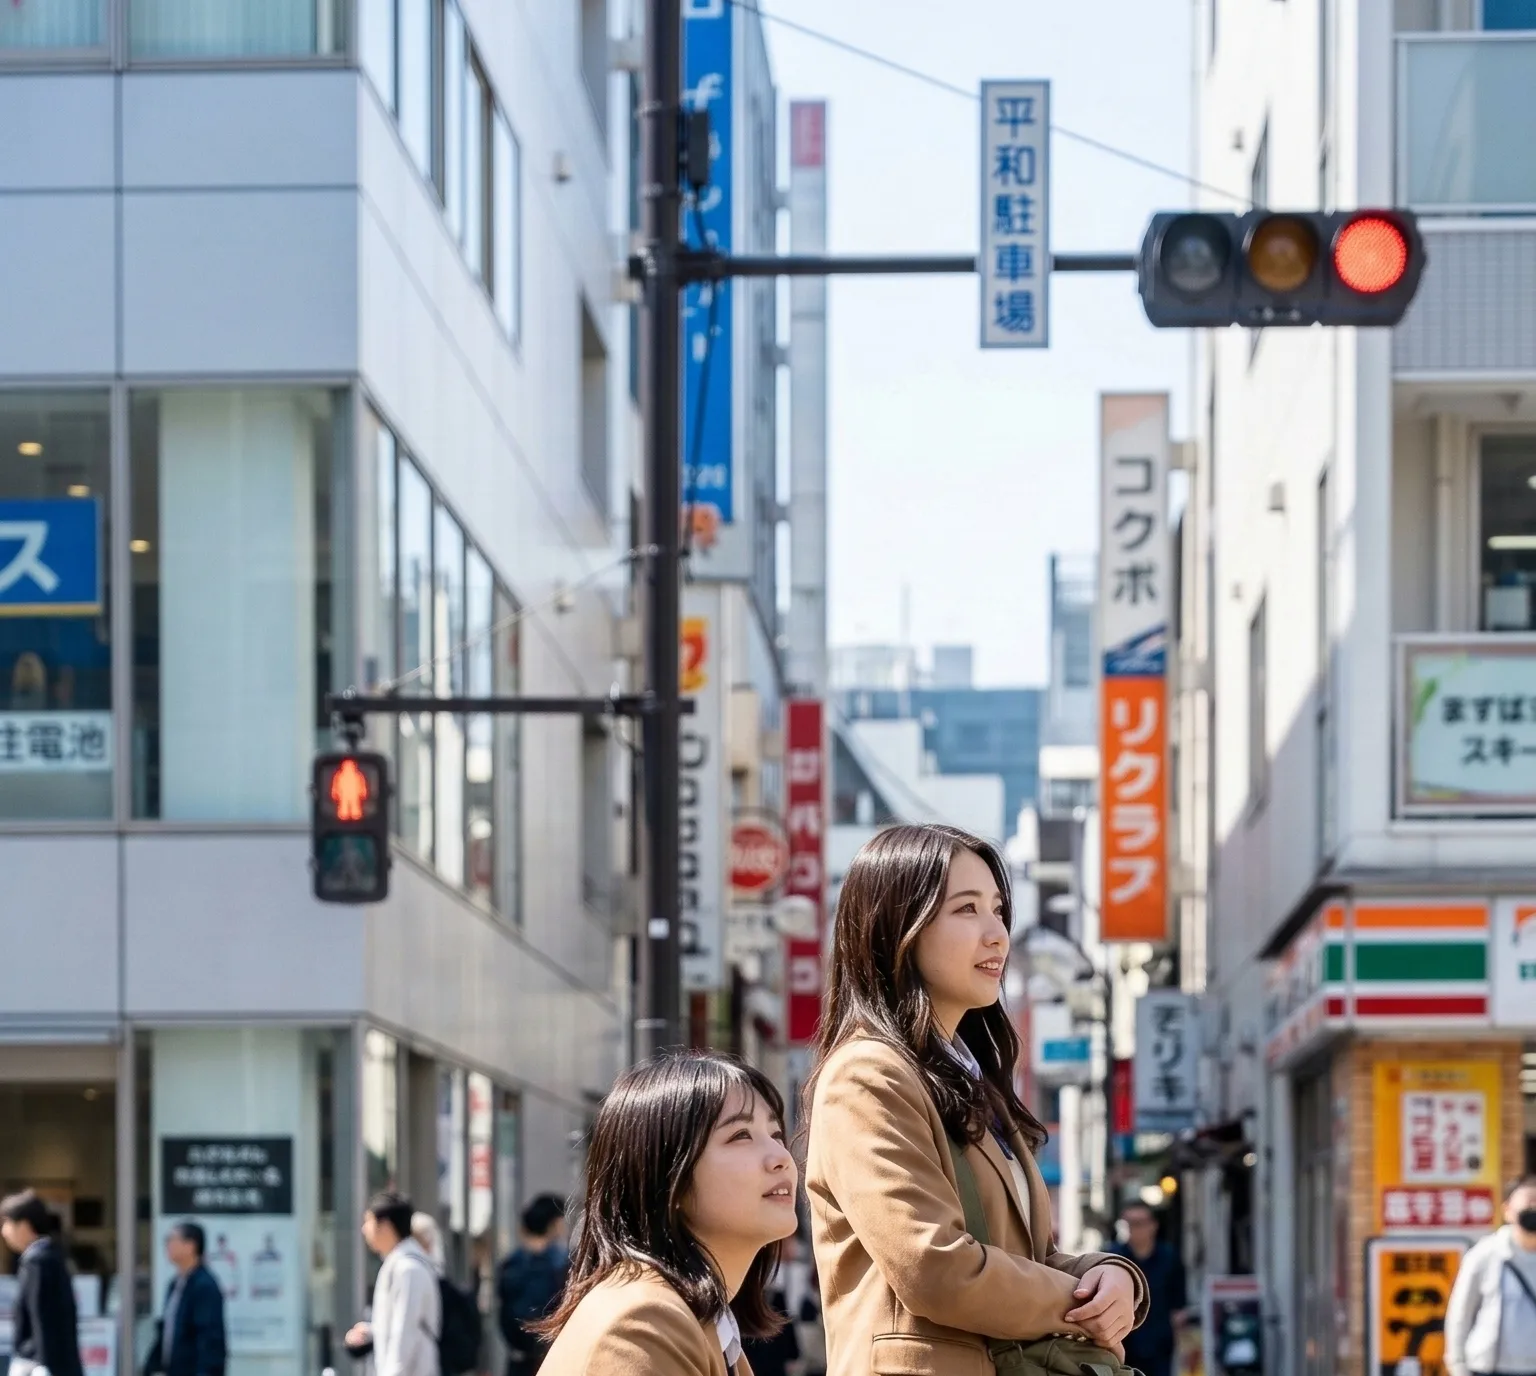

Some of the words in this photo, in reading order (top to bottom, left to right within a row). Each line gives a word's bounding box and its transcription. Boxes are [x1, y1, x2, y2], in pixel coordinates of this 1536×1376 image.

[993, 96, 1036, 333] 平和駐車場
